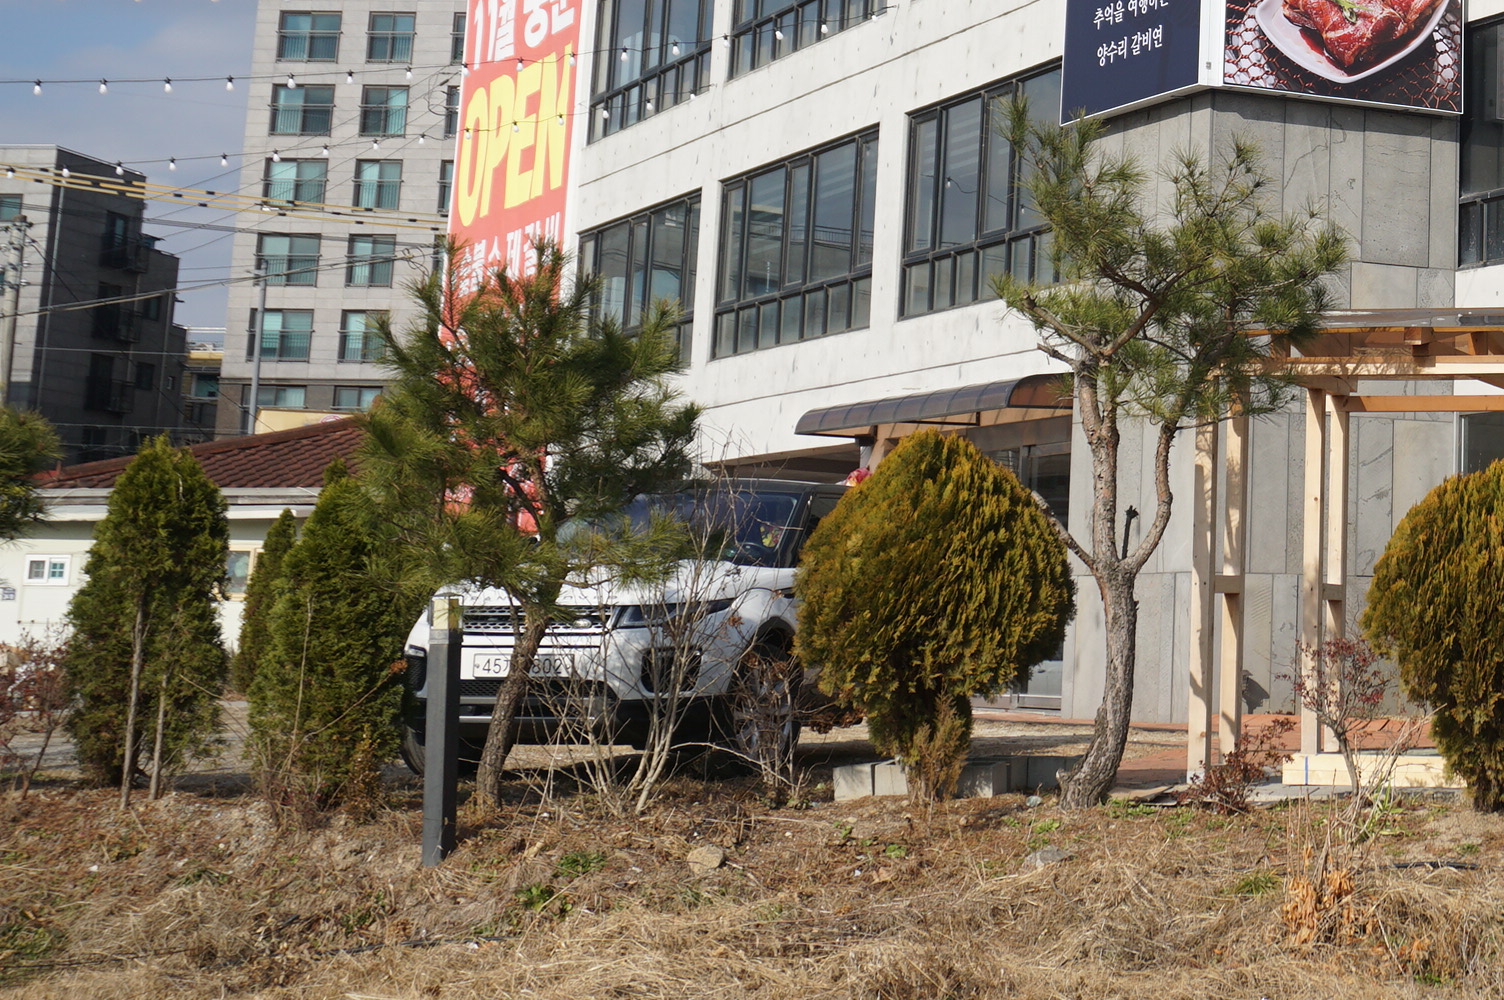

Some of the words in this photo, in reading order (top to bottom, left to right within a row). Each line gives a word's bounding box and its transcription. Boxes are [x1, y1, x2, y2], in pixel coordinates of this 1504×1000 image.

[1093, 0, 1125, 30] 추억을
[1097, 36, 1127, 67] 양수리
[1130, 24, 1163, 56] 갈비연
[457, 40, 574, 227] OPEN
